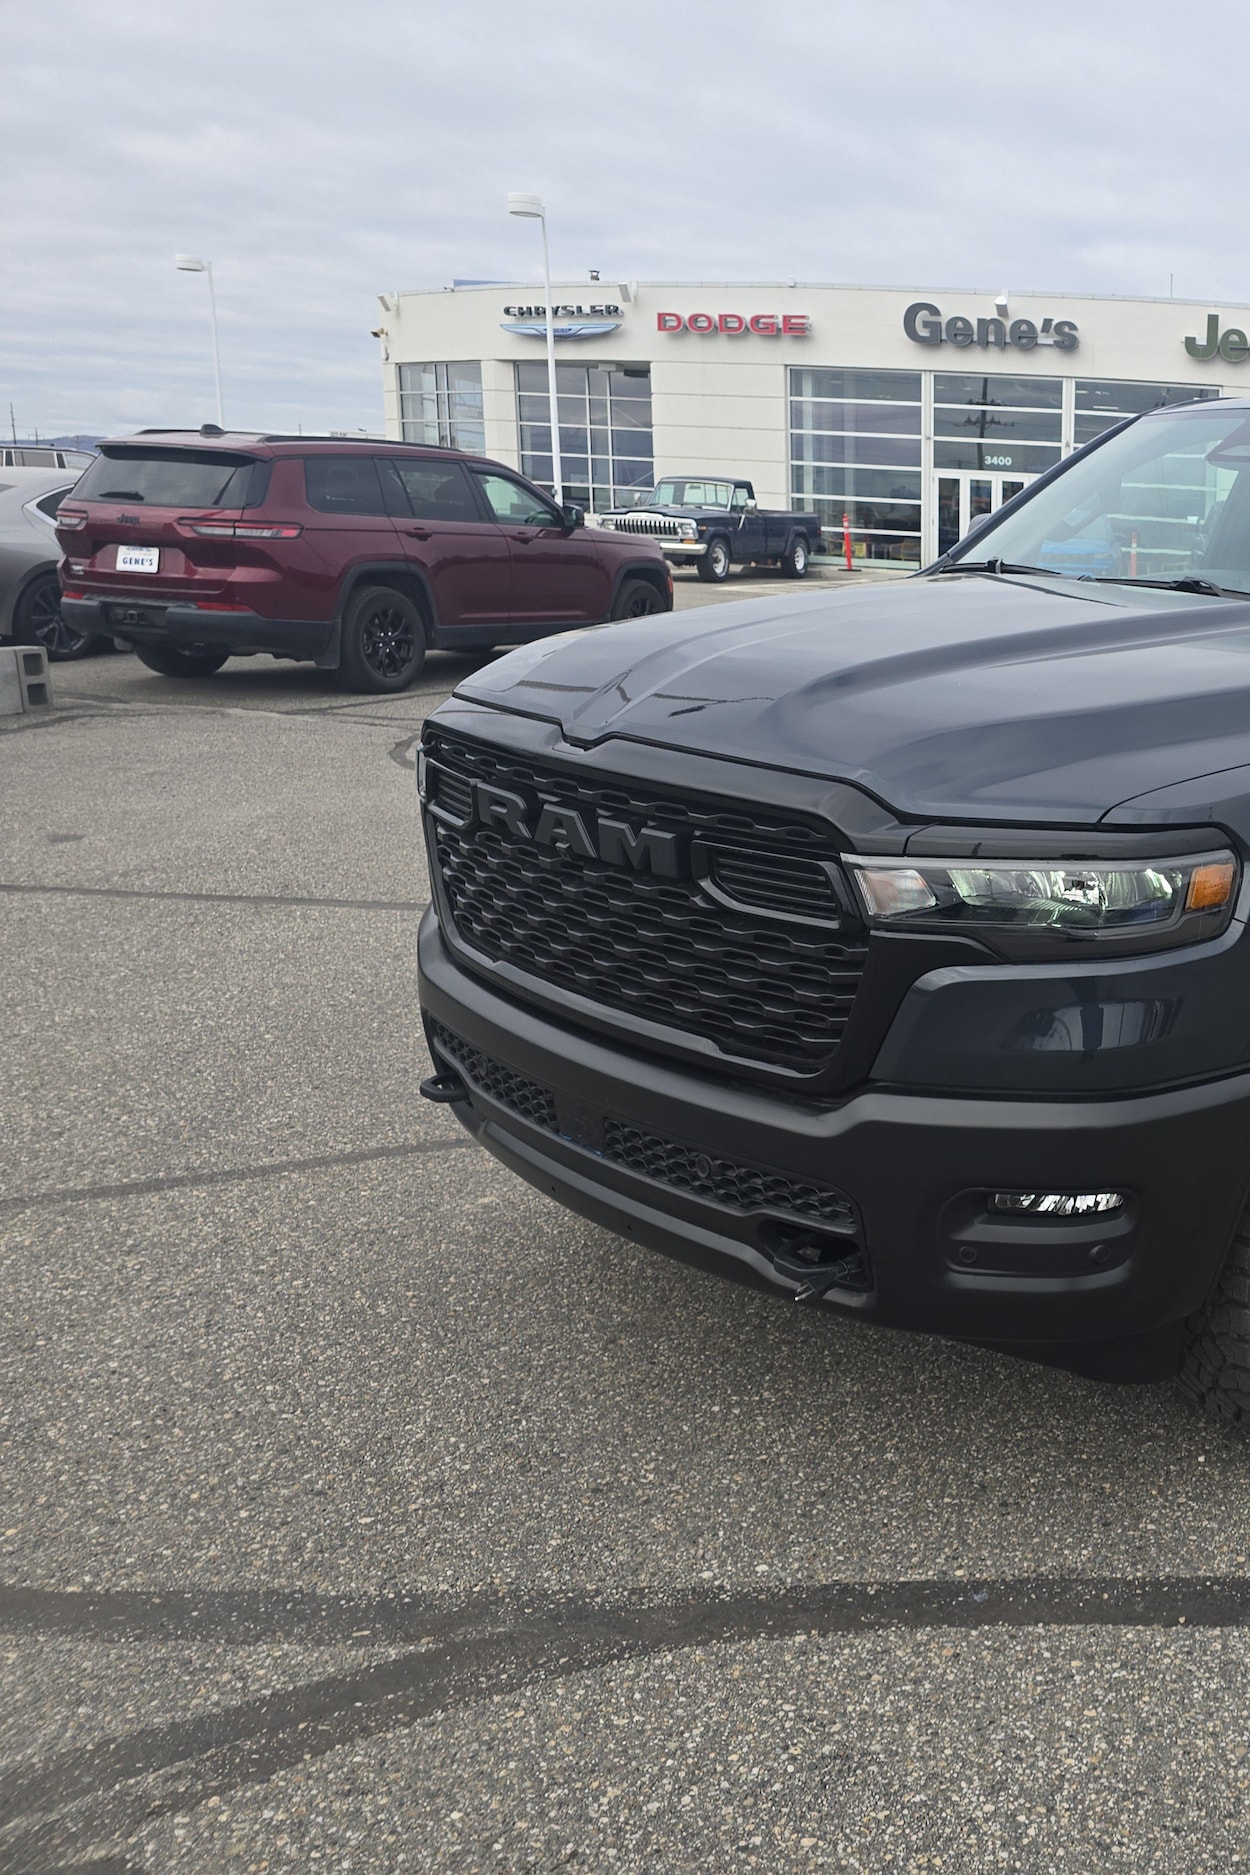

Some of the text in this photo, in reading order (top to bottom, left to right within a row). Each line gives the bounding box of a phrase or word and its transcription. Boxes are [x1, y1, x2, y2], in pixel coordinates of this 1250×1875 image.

[656, 312, 809, 336] DODGE
[903, 301, 1080, 351] Gene's
[984, 455, 1012, 466] 3400
[122, 556, 154, 567] GENE'S
[475, 781, 680, 879] RAM
